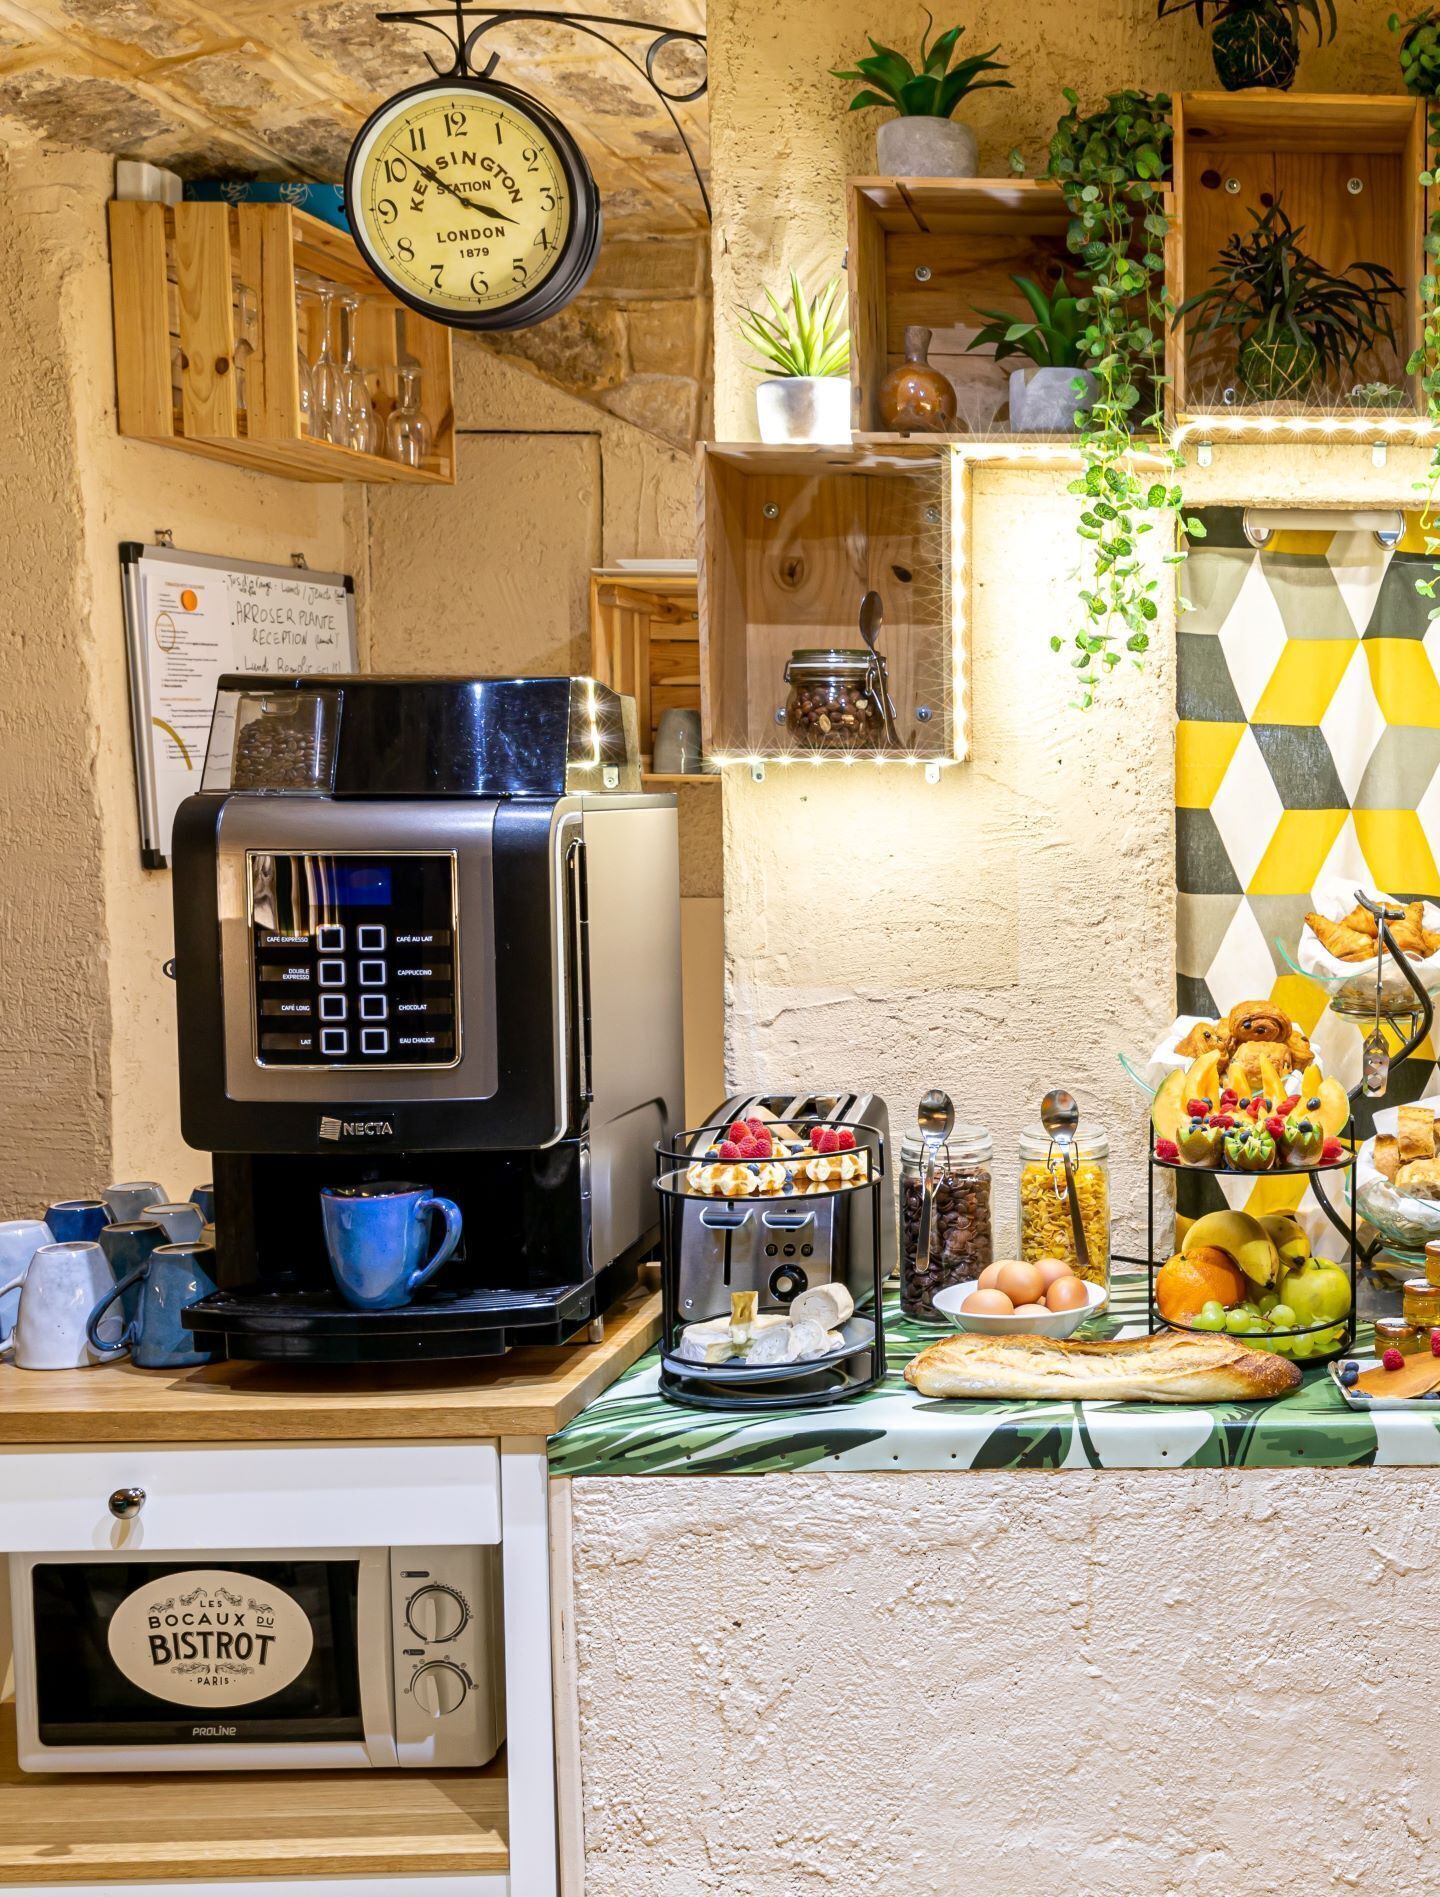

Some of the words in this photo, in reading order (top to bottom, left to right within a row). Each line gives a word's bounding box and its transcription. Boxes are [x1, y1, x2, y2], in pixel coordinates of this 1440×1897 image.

[443, 111, 468, 138] 12
[495, 122, 503, 145] 1
[408, 127, 427, 152] 11
[384, 157, 408, 183] 10
[522, 148, 539, 172] 2
[436, 180, 492, 195] STATION
[377, 198, 398, 224] 9
[539, 187, 556, 212] 3
[437, 226, 506, 243] LONDON
[533, 228, 552, 251] 4
[396, 237, 415, 262] 8
[459, 247, 490, 259] 1879
[430, 264, 444, 289] 7
[512, 258, 528, 284] 5
[470, 271, 489, 295] 6
[236, 600, 296, 625] ARROSER
[299, 610, 336, 630] PLANTE
[252, 627, 308, 646] RECEPTION
[266, 935, 280, 943] CAFÉ
[396, 934, 411, 943] CAFÉ
[343, 1121, 393, 1136] NECTA
[200, 1600, 223, 1608] LES
[148, 1612, 246, 1630] BOCAUX
[256, 1616, 275, 1626] DU
[148, 1630, 276, 1666] BISTROT
[197, 1676, 230, 1686] PARIS
